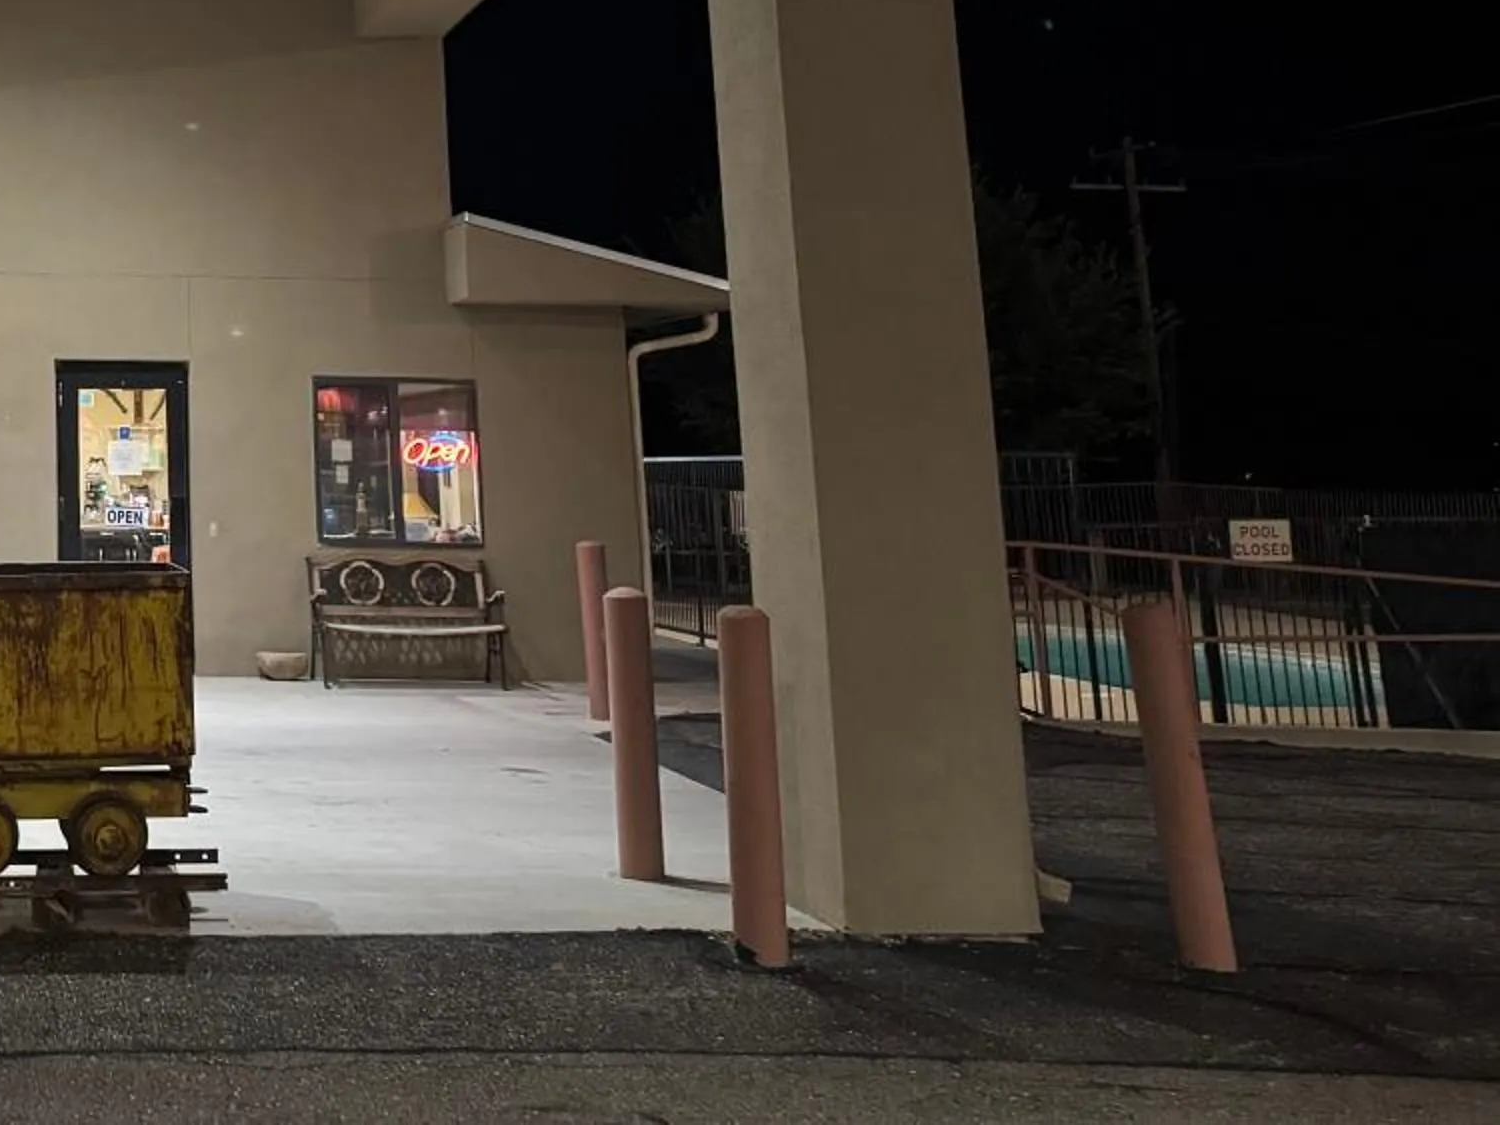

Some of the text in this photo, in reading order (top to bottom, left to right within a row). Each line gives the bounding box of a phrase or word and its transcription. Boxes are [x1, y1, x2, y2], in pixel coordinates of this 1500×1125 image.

[107, 510, 144, 524] OPEN
[1239, 526, 1280, 539] POOL
[1233, 542, 1290, 556] CLOSED
